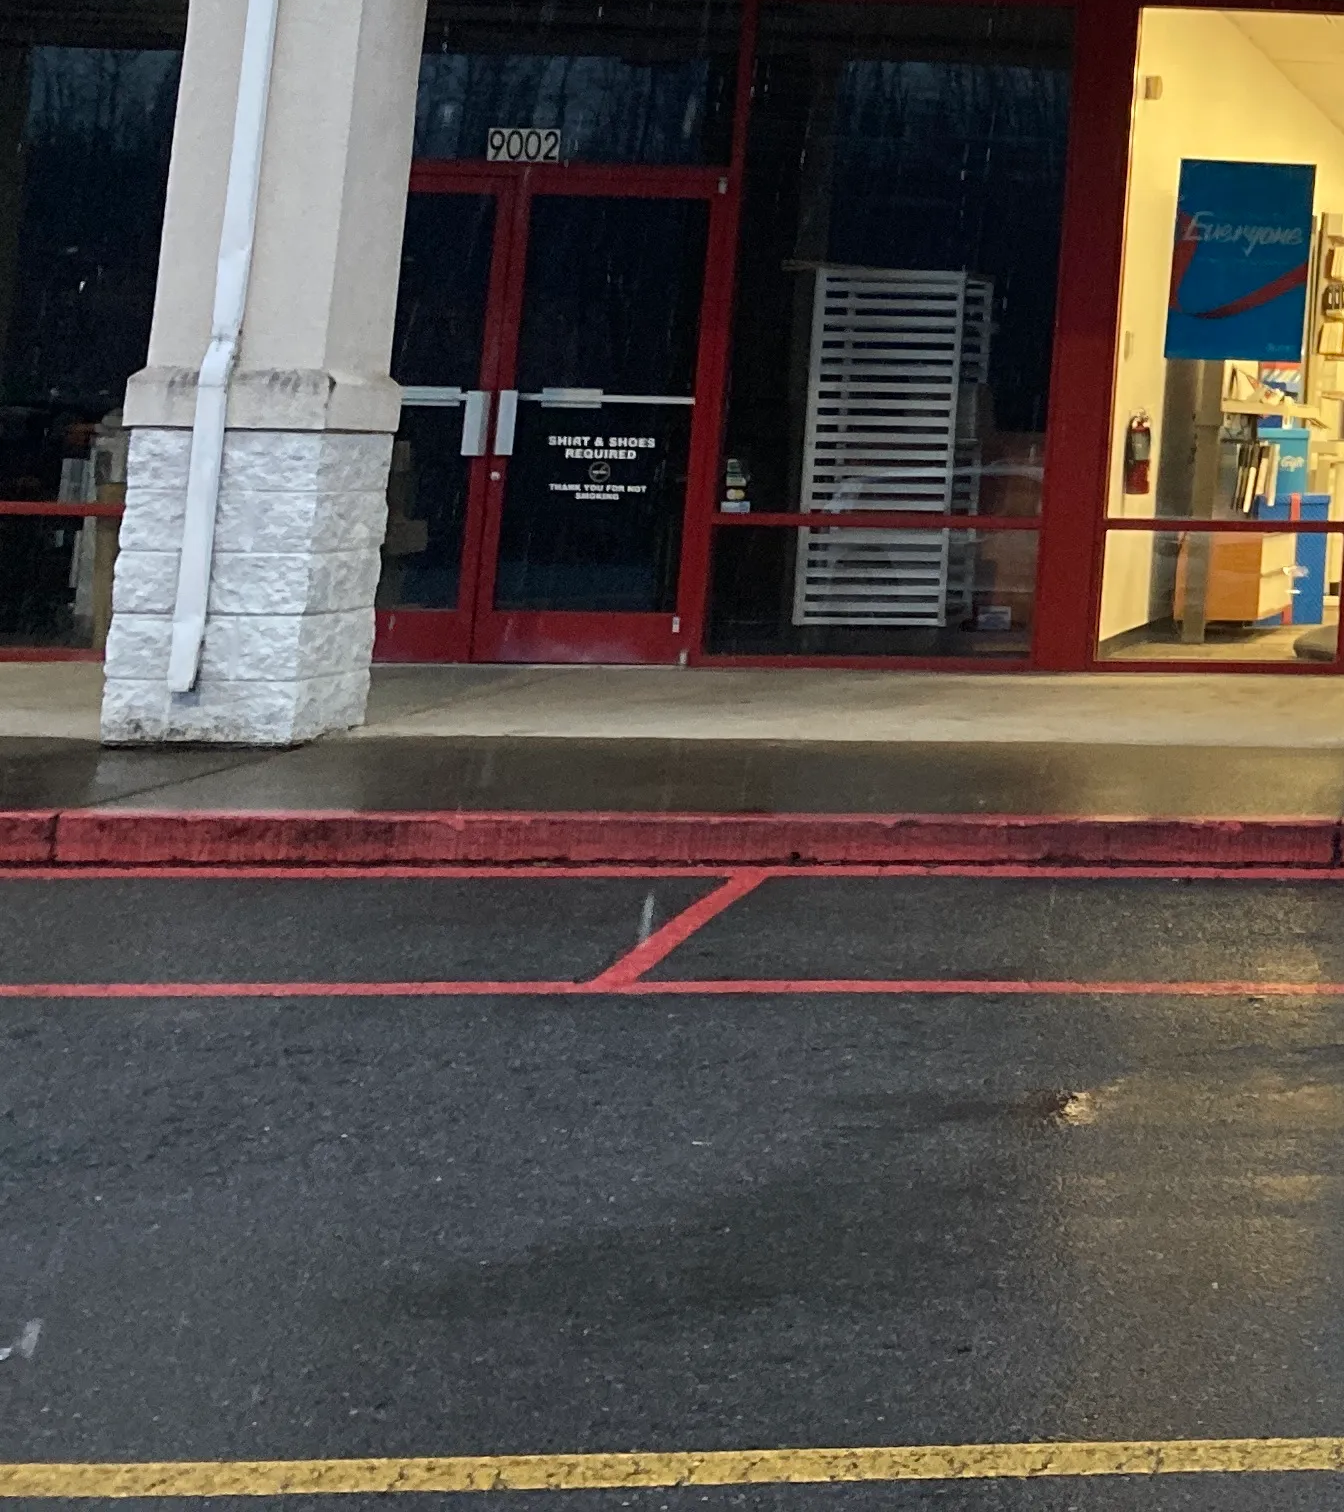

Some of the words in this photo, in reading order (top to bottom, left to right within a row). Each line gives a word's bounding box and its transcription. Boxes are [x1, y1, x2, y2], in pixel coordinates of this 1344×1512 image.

[490, 130, 559, 160] 9002
[1183, 211, 1302, 256] Everyone
[548, 436, 590, 447] SHIRT
[594, 437, 604, 447] &
[608, 437, 656, 448] SHOES
[565, 448, 637, 459] REQUIRED
[549, 483, 581, 491] THANK
[584, 484, 603, 492] YOU
[606, 484, 625, 492] FOR
[627, 485, 647, 493] NOT
[575, 492, 619, 500] SMOKING
